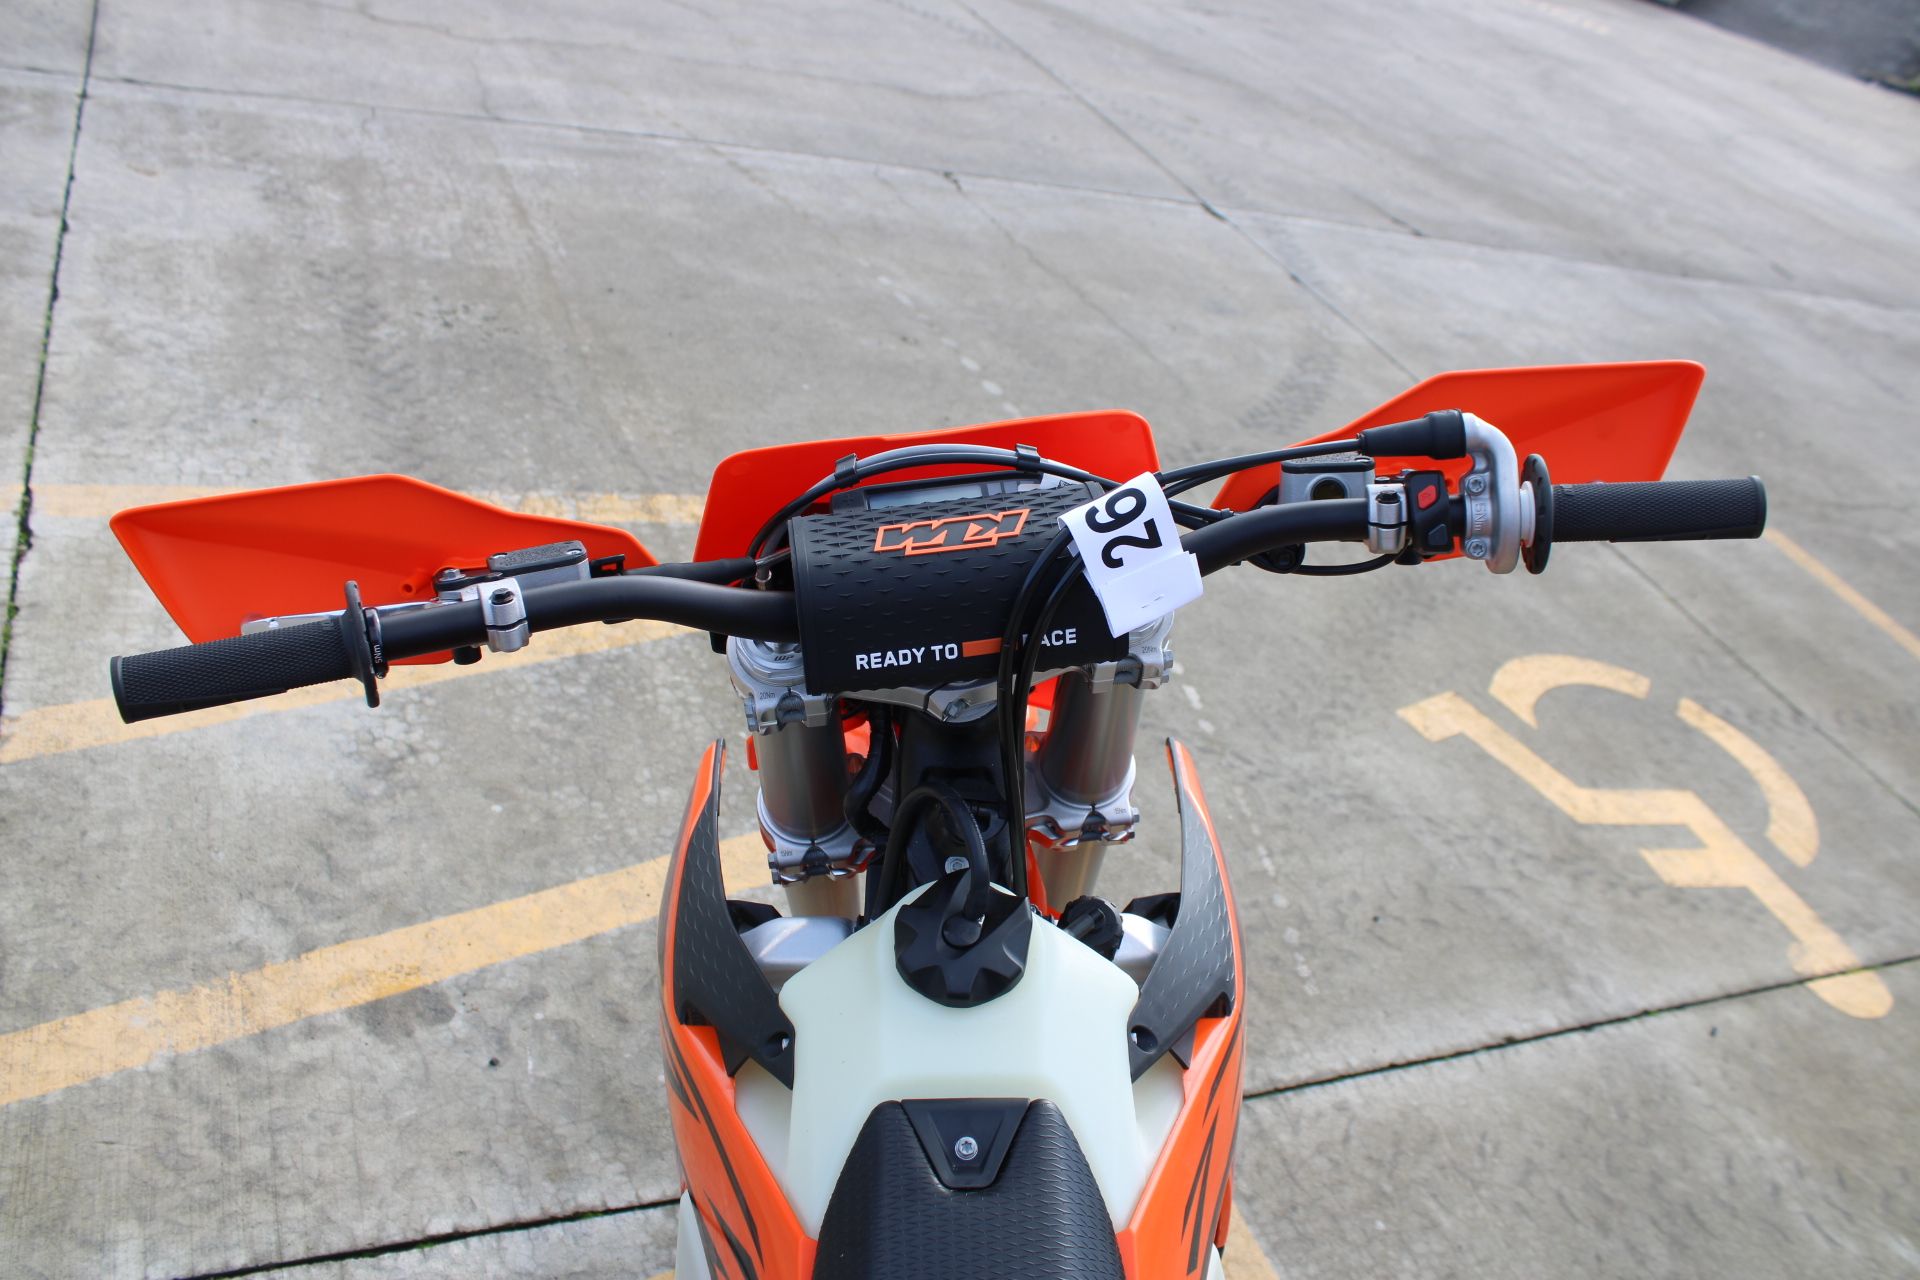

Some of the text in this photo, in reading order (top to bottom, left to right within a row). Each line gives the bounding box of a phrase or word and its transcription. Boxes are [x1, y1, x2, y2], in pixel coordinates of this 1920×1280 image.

[874, 508, 1031, 557] KTM
[1084, 487, 1163, 569] 26
[855, 628, 1077, 671] READY TO ACE
[759, 691, 776, 700] 20Nm
